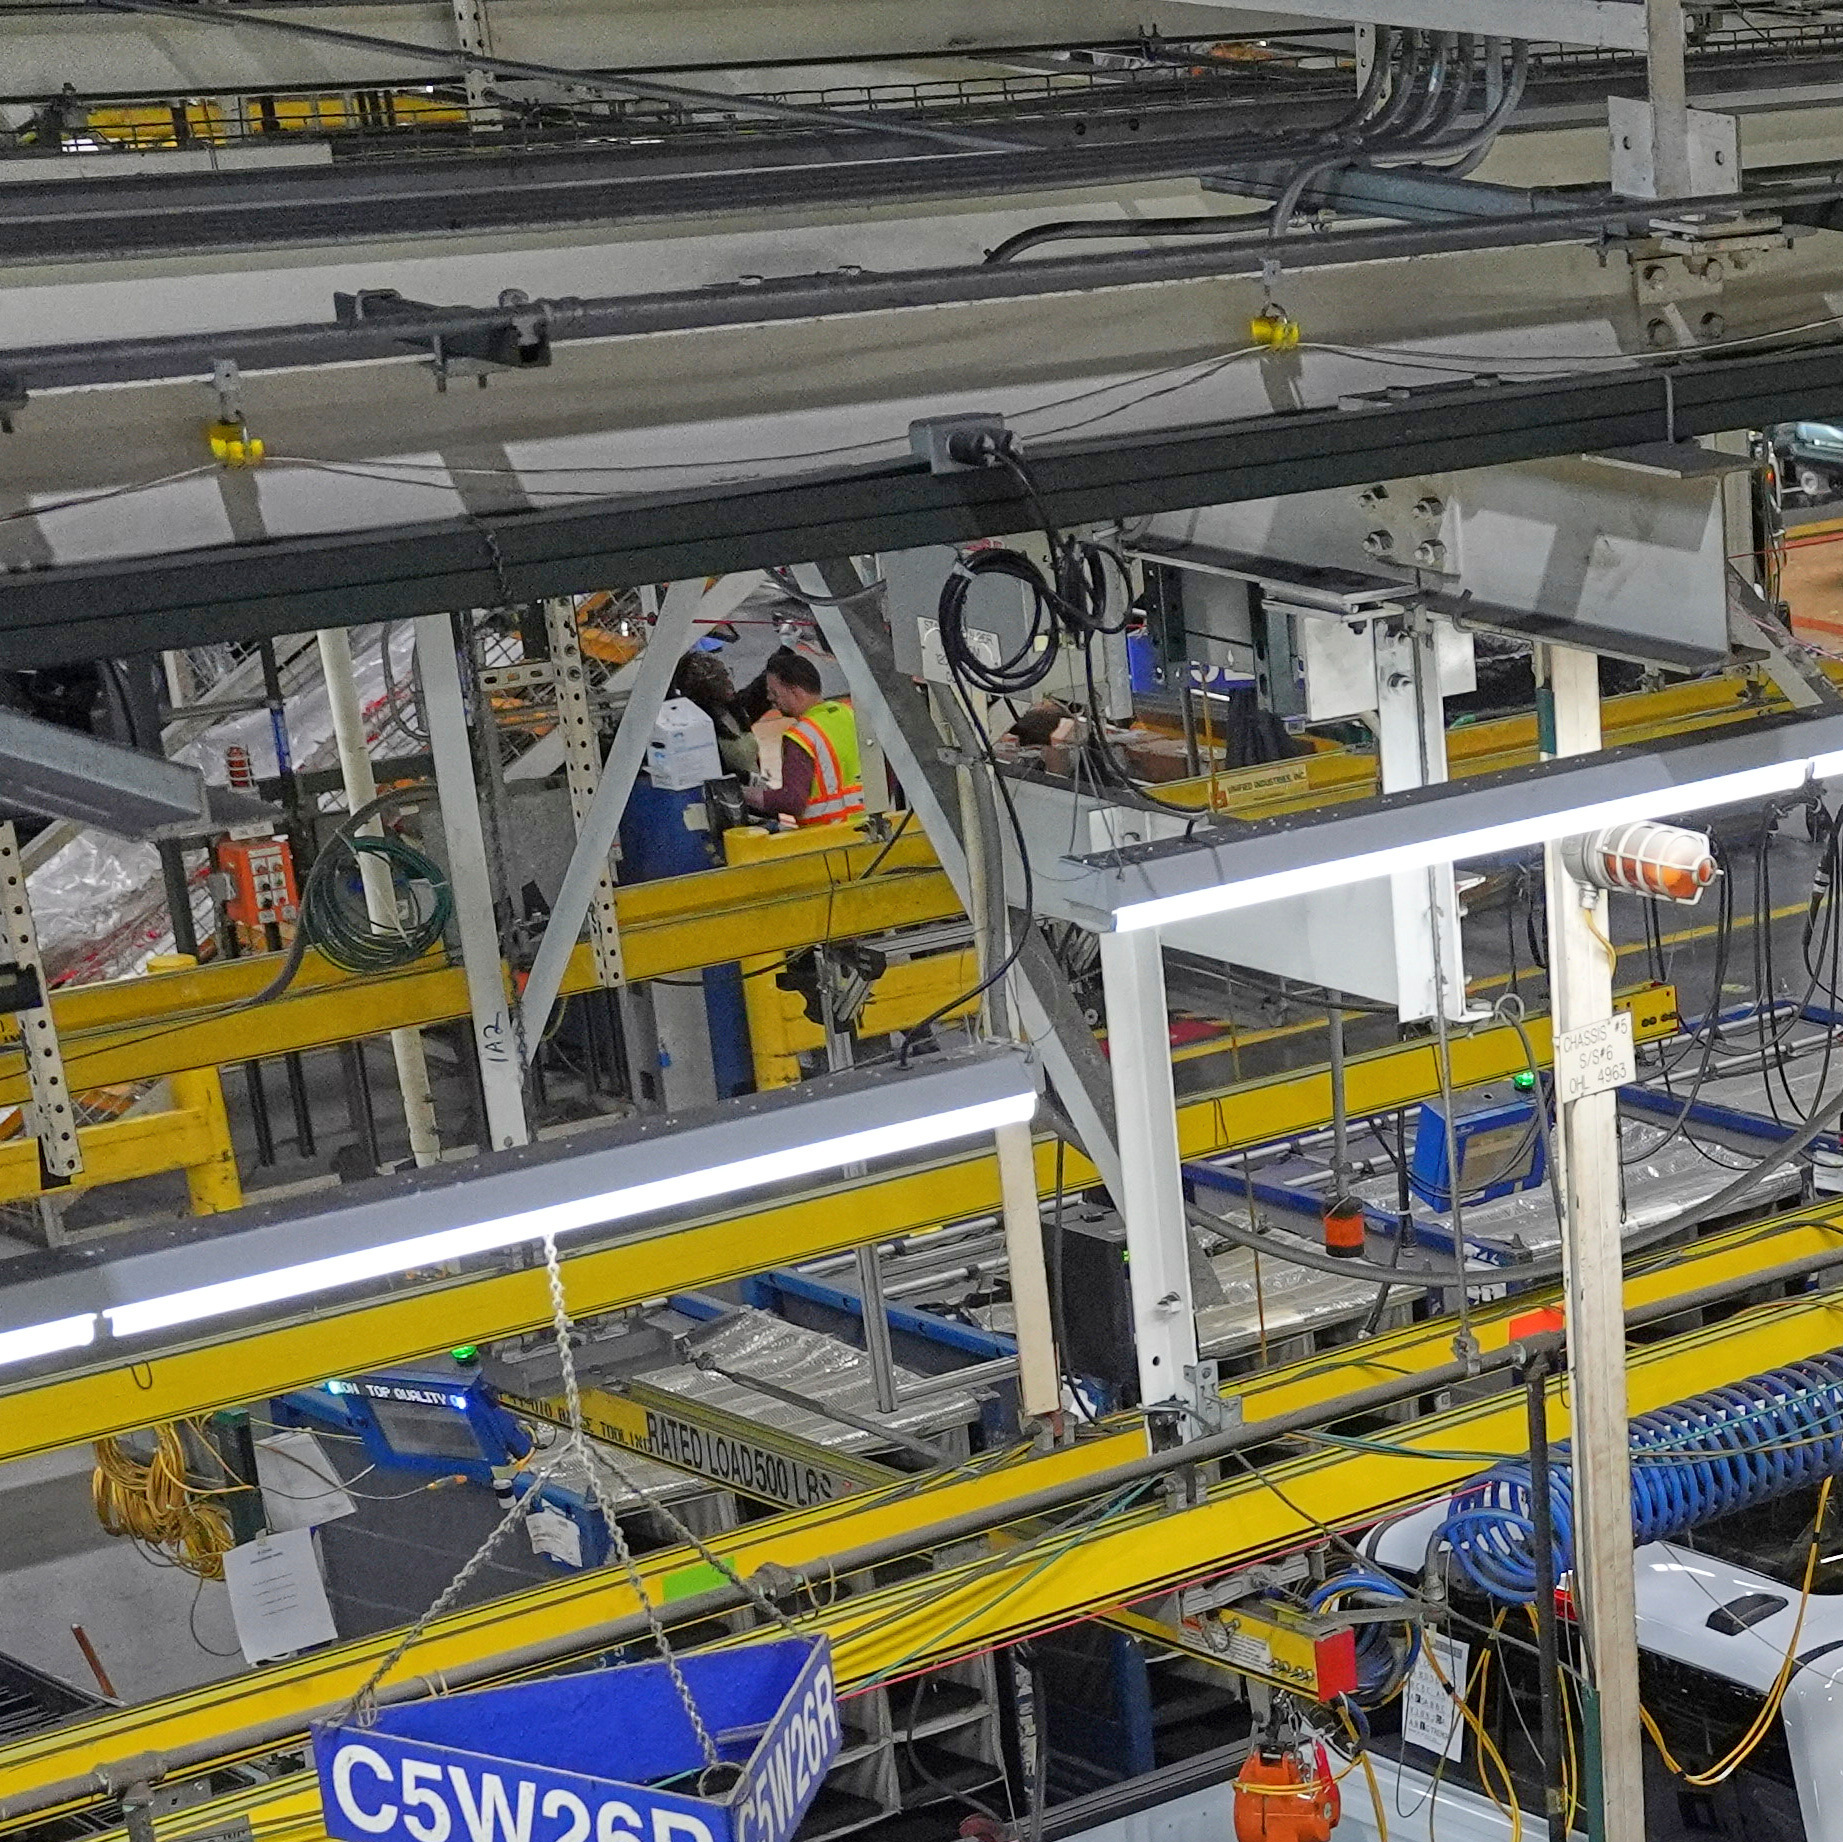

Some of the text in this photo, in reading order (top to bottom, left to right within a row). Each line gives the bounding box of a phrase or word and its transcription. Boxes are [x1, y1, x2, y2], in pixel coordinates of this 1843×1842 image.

[1563, 1017, 1628, 1053] CHASSIS #5
[1569, 1062, 1627, 1094] OHL 4963
[364, 1384, 391, 1398] TOP
[393, 1387, 447, 1405] QUALITY
[646, 1410, 702, 1468] RATED
[706, 1431, 753, 1484] LOAD
[753, 1449, 789, 1501] 500
